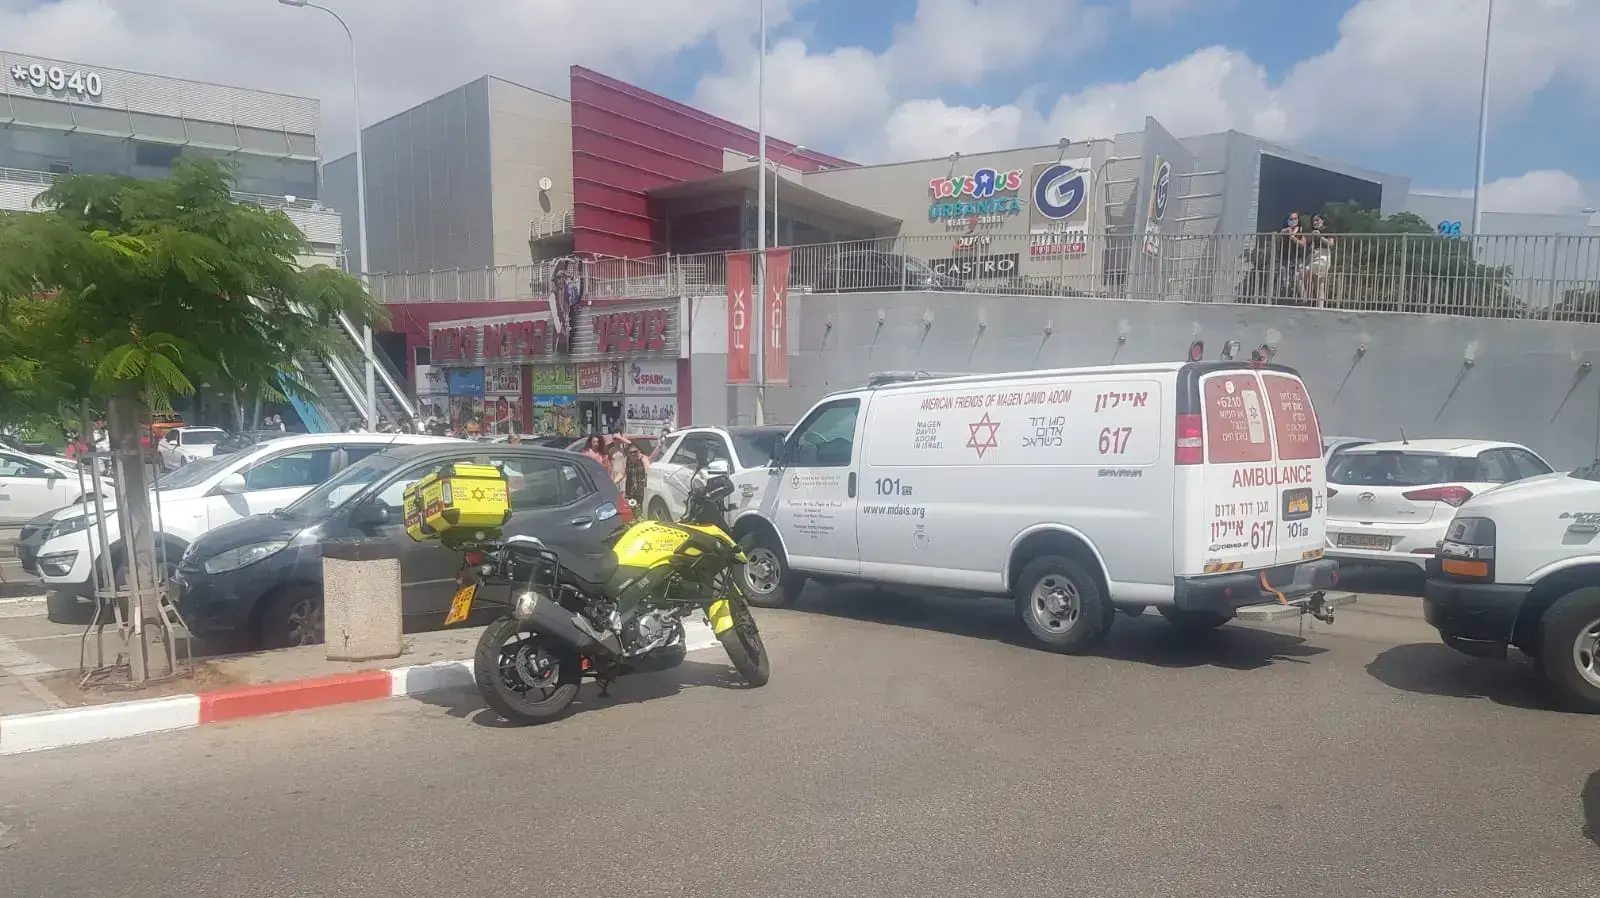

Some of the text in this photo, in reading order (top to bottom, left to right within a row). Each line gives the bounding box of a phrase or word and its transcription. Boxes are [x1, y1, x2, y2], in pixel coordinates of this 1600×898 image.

[1034, 164, 1086, 220] G
[929, 196, 1021, 219] URBANICA
[935, 259, 1014, 275] CASRO
[733, 287, 745, 349] FOX
[920, 389, 1072, 411] AMERICAN FRIENDS OF MAGEN DAVID ADOM
[1094, 391, 1148, 413] איילון
[917, 420, 942, 428] MAGEN
[1028, 417, 1046, 427] דוד
[1036, 427, 1064, 437] אדום
[1098, 426, 1133, 455] 617
[1232, 464, 1312, 488] AMBULANCE
[875, 478, 901, 496] 101
[863, 504, 926, 519] www.mdais.org
[1215, 503, 1237, 518] אדום
[1239, 501, 1254, 516] דוד
[1211, 519, 1274, 550] איילון 617
[1287, 522, 1303, 539] 101
